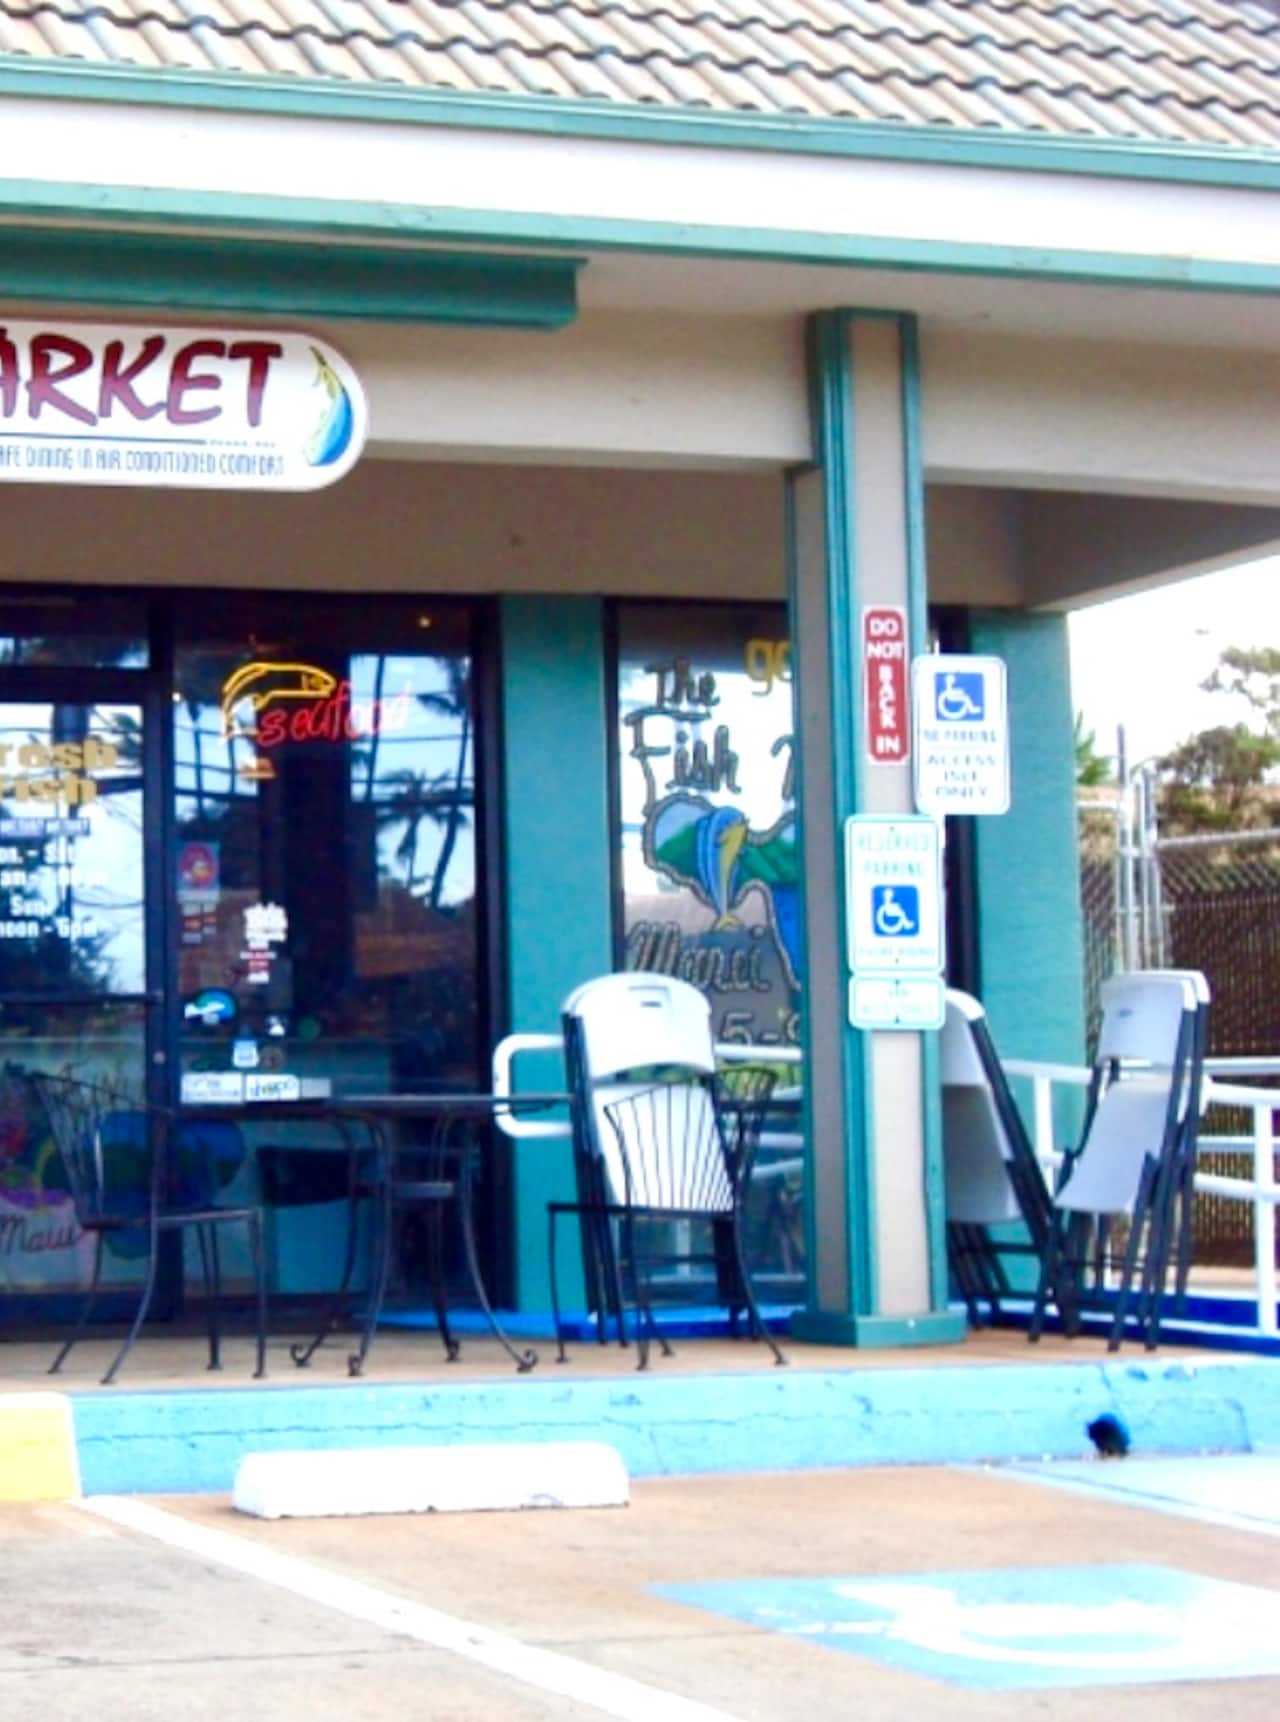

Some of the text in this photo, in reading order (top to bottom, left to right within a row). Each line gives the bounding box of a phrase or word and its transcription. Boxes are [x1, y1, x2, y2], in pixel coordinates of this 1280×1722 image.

[125, 449, 216, 474] CONDITIONED
[869, 617, 900, 637] DO
[866, 642, 904, 659] NOT
[644, 655, 721, 707] The
[878, 664, 897, 729] BACK
[875, 735, 901, 754] IN
